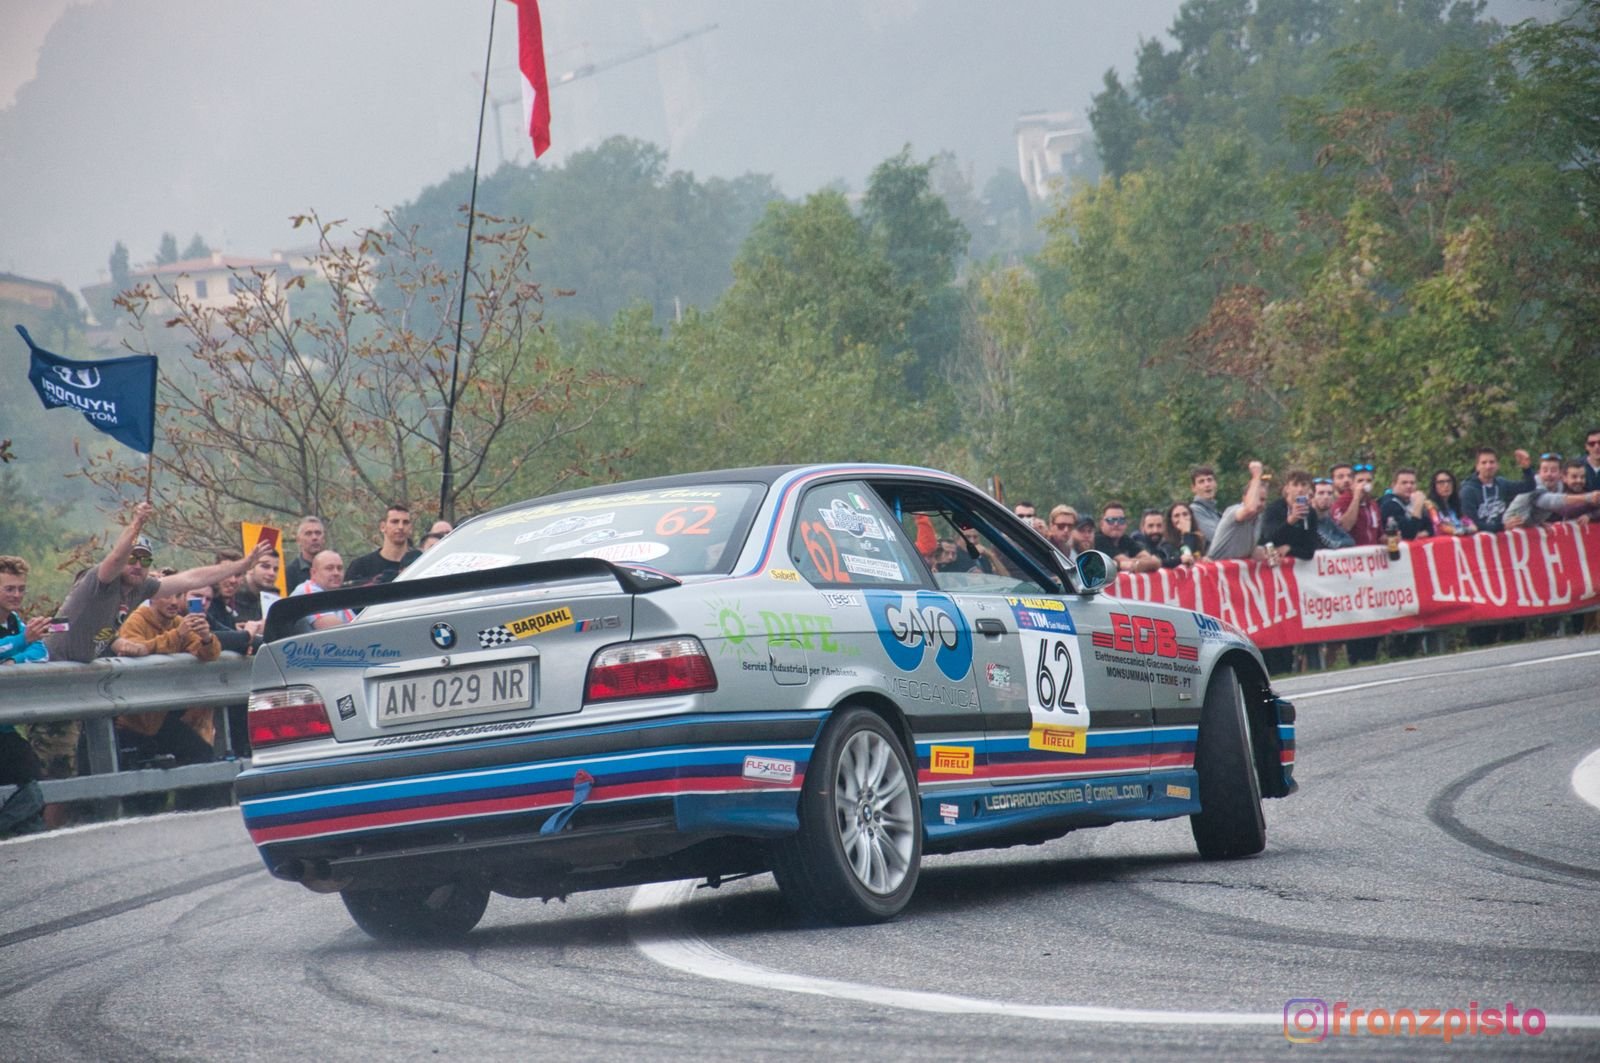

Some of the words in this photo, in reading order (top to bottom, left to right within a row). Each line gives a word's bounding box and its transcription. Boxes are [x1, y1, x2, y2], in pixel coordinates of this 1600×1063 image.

[656, 504, 717, 537] 62
[800, 520, 852, 583] 62
[1316, 555, 1365, 580] L'acqua
[1366, 548, 1389, 577] più
[1302, 591, 1353, 620] leggera
[1354, 586, 1414, 611] d'Europa
[512, 609, 571, 633] BARDAHL
[1028, 611, 1049, 629] TIM
[1109, 612, 1178, 659] EGB
[281, 640, 320, 659] Jolly
[321, 642, 366, 659] Racing
[367, 643, 401, 658] Team
[742, 661, 768, 672] Servizi
[769, 660, 808, 674] Industriali
[809, 666, 821, 677] per
[1036, 638, 1079, 715] 62
[1146, 658, 1173, 671] Giacomo
[1106, 666, 1155, 683] MONSUMMANO
[1156, 673, 1179, 686] TERME
[1183, 677, 1191, 688] PT
[385, 683, 417, 716] AN
[432, 674, 481, 708] 029
[492, 669, 524, 700] NR
[883, 675, 980, 709] MECCANICA
[1042, 728, 1075, 748] PIRELLI
[745, 760, 792, 773] FLEXILOG
[935, 751, 970, 769] PIRELLI
